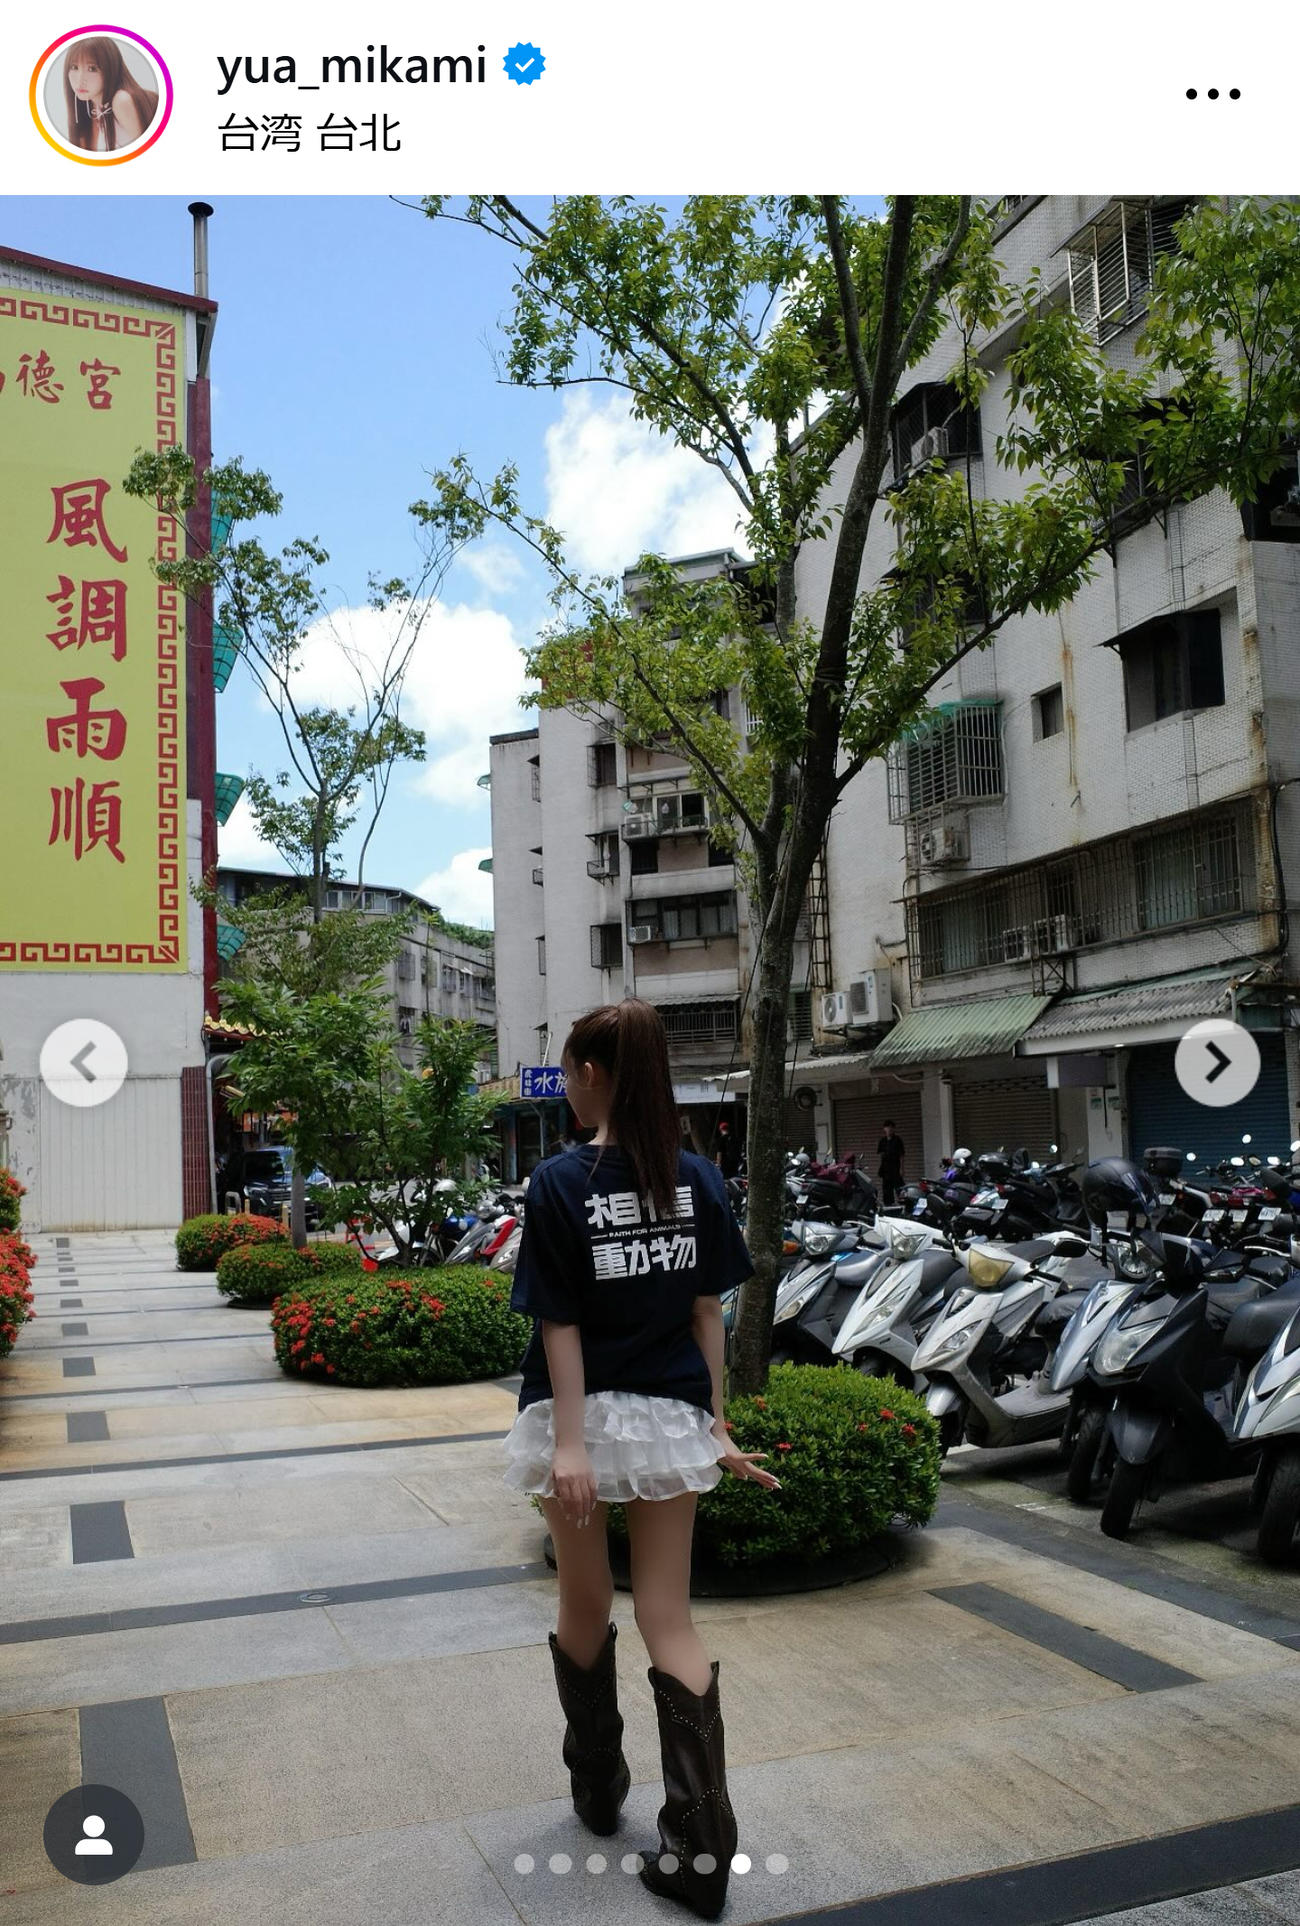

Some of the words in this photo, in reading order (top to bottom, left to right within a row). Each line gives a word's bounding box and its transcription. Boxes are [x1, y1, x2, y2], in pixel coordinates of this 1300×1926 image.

[0, 349, 121, 410] 德宮
[46, 478, 128, 863] 風調雨順
[591, 1234, 697, 1281] 動物
